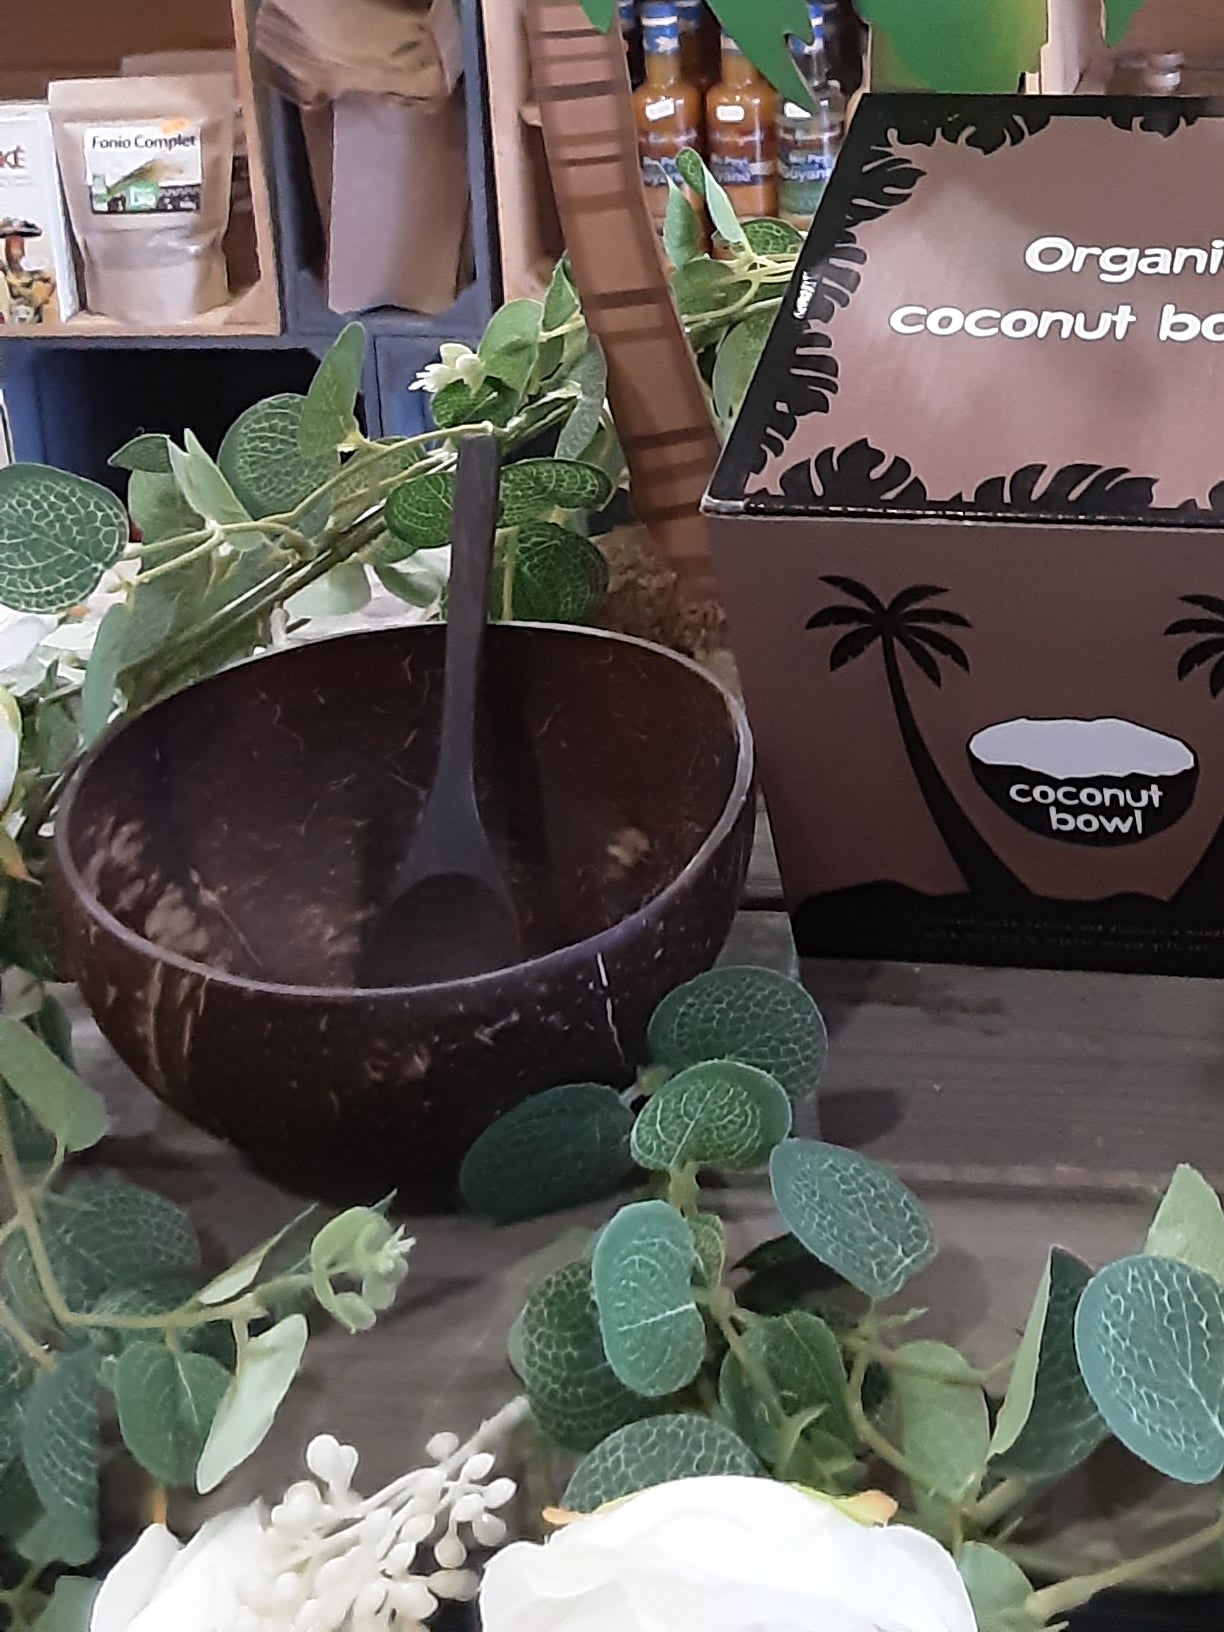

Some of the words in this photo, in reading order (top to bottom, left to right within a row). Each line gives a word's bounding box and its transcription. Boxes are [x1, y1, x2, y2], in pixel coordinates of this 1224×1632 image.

[92, 135, 131, 149] Fonio
[134, 134, 196, 151] Complet
[888, 302, 1138, 342] coconut
[1009, 783, 1163, 808] coconut
[1049, 805, 1143, 835] bowl
